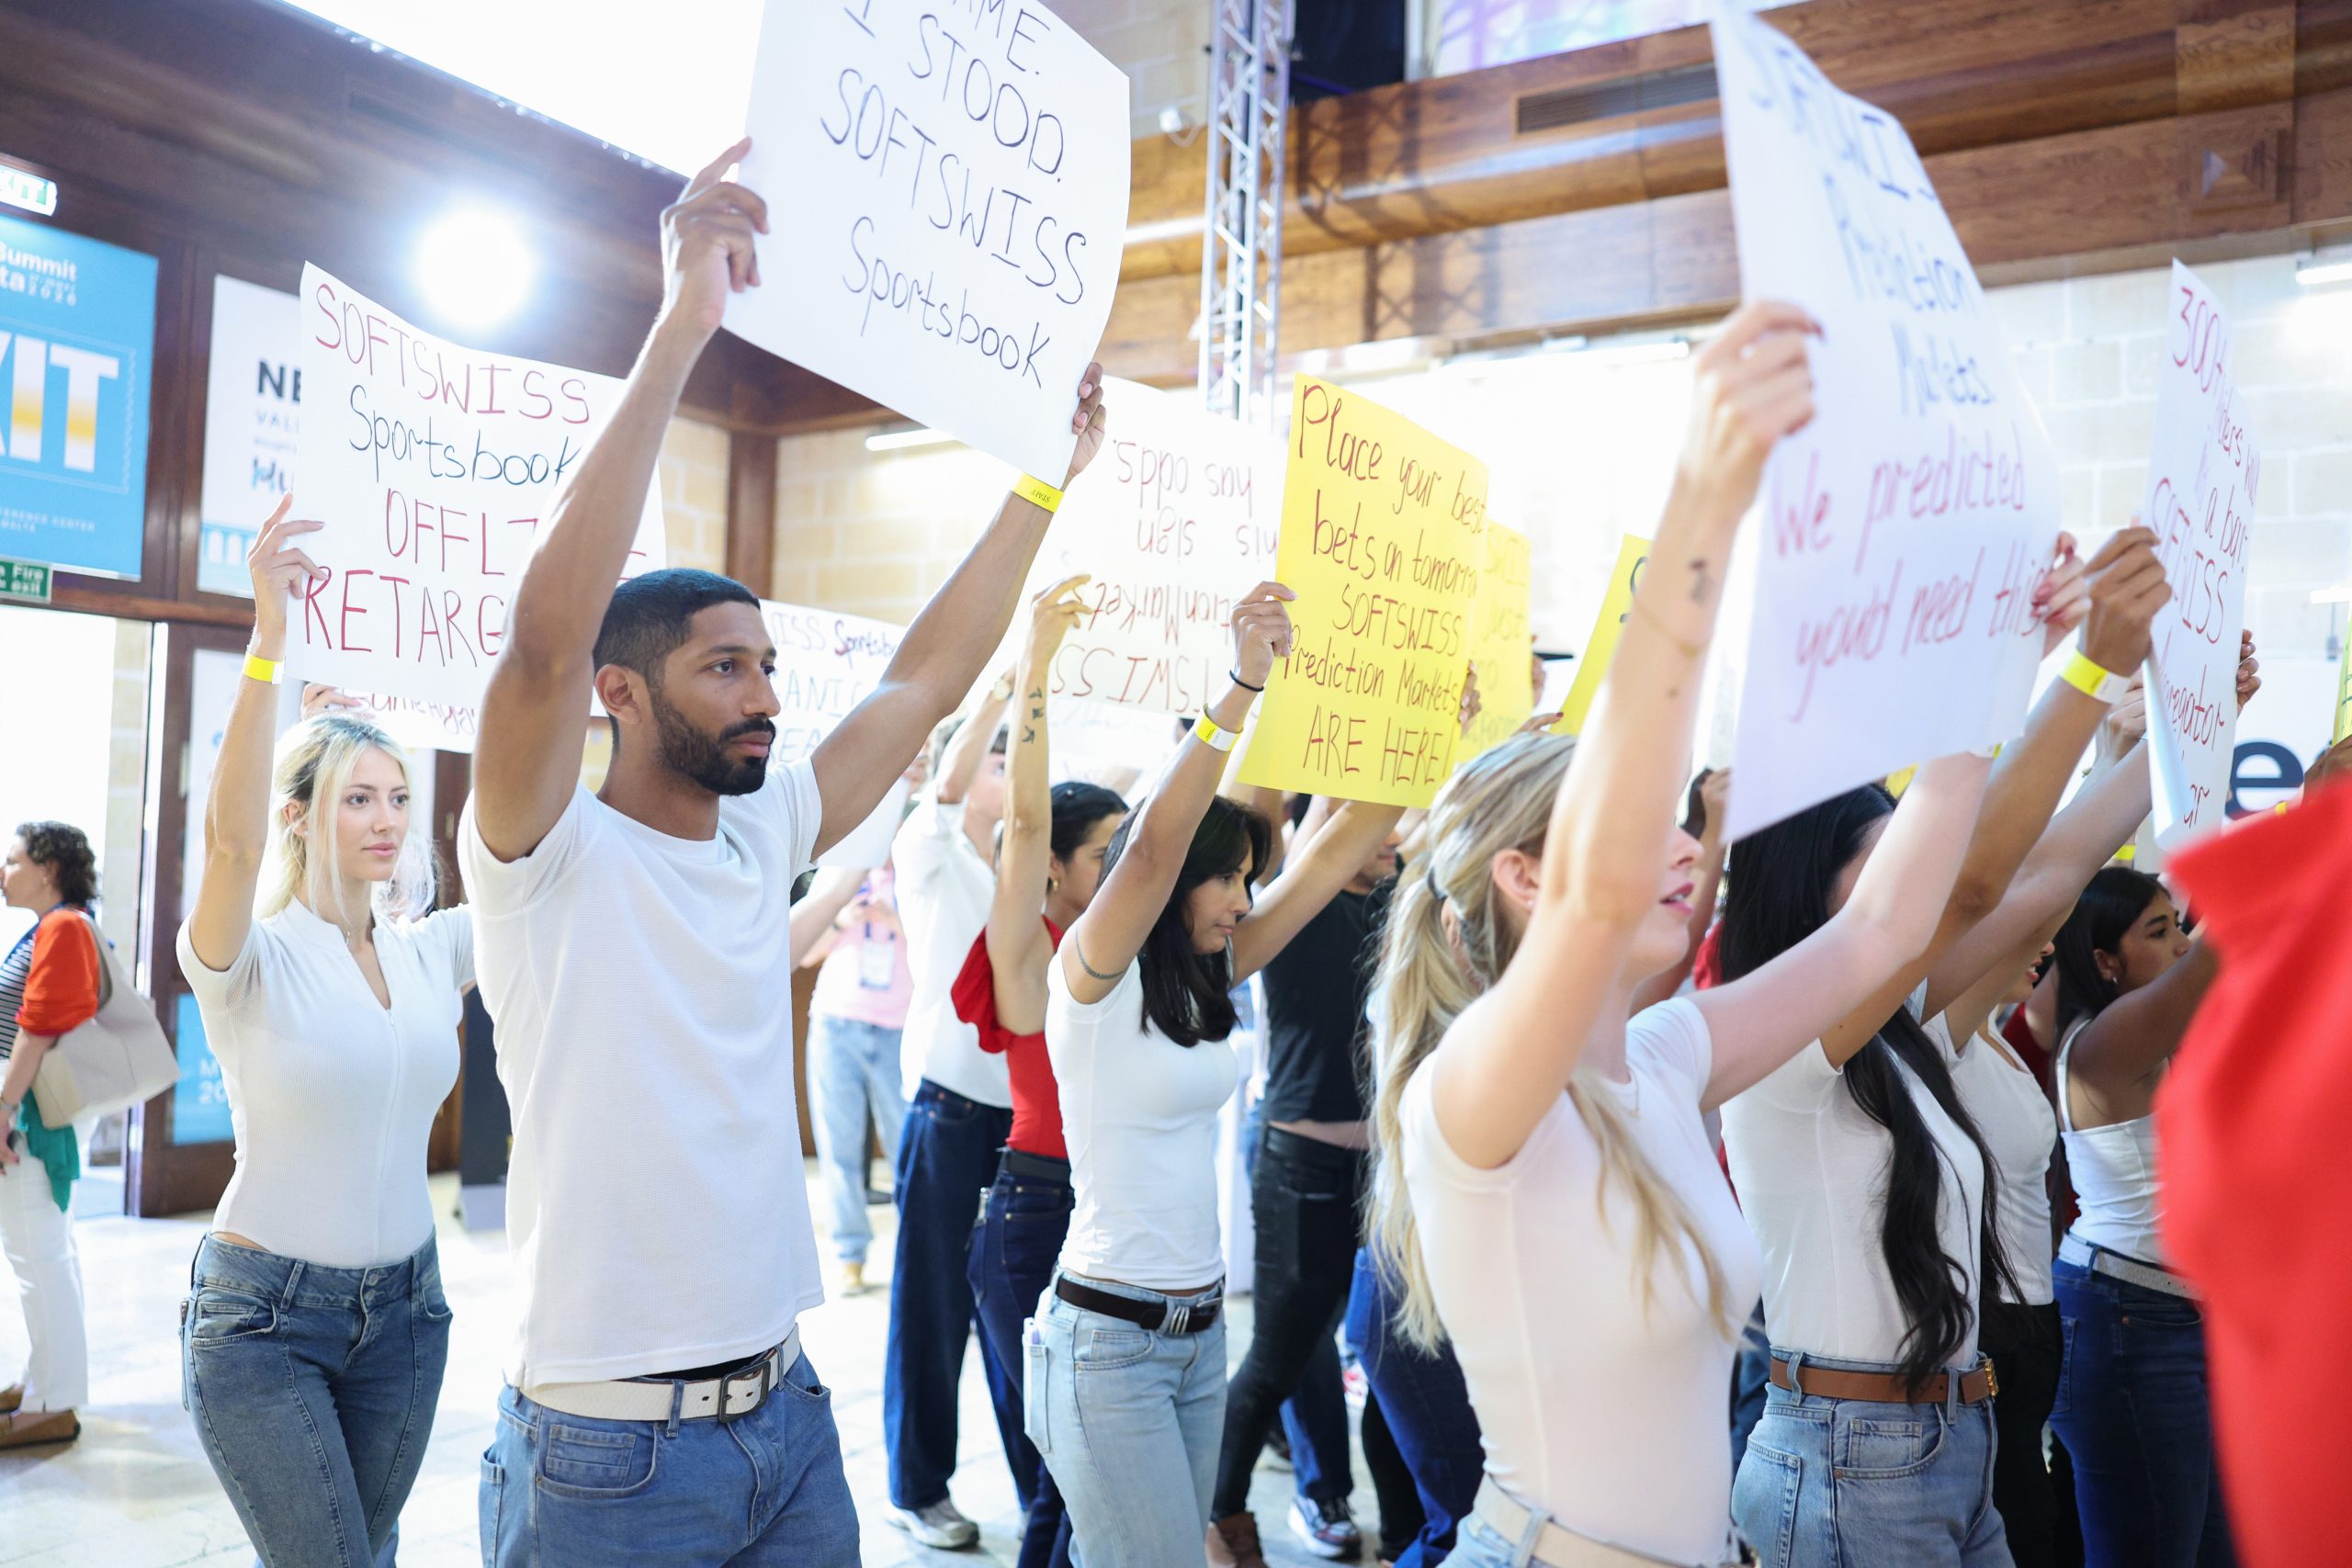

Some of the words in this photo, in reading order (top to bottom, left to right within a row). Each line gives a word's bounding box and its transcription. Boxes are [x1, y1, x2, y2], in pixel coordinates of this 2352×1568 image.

[909, 14, 1064, 183] STOOD.
[820, 69, 1087, 305] SOFTSWISS
[315, 283, 590, 424] SOFTSWISS
[842, 217, 1051, 389] Sportsbook
[0, 329, 119, 473] IT
[348, 384, 584, 487] Sportsbook
[1113, 438, 1190, 510] odds.
[1204, 462, 1253, 519] has
[1298, 384, 1383, 481] Place
[1393, 456, 1442, 514] your
[1451, 469, 1487, 534] best
[1771, 448, 1834, 559] We
[1852, 420, 2026, 575] predicted
[1136, 506, 1196, 565] sign
[1313, 489, 1376, 581] bets
[304, 565, 504, 668] RETARG
[833, 618, 898, 671] Sportsb
[1332, 583, 1463, 658] SOFTSWISS
[1901, 544, 1985, 658] need
[1283, 625, 1385, 698] Prediction
[1396, 660, 1459, 716] Markets
[1302, 704, 1367, 780] ARE
[1379, 716, 1458, 788] HERE!
